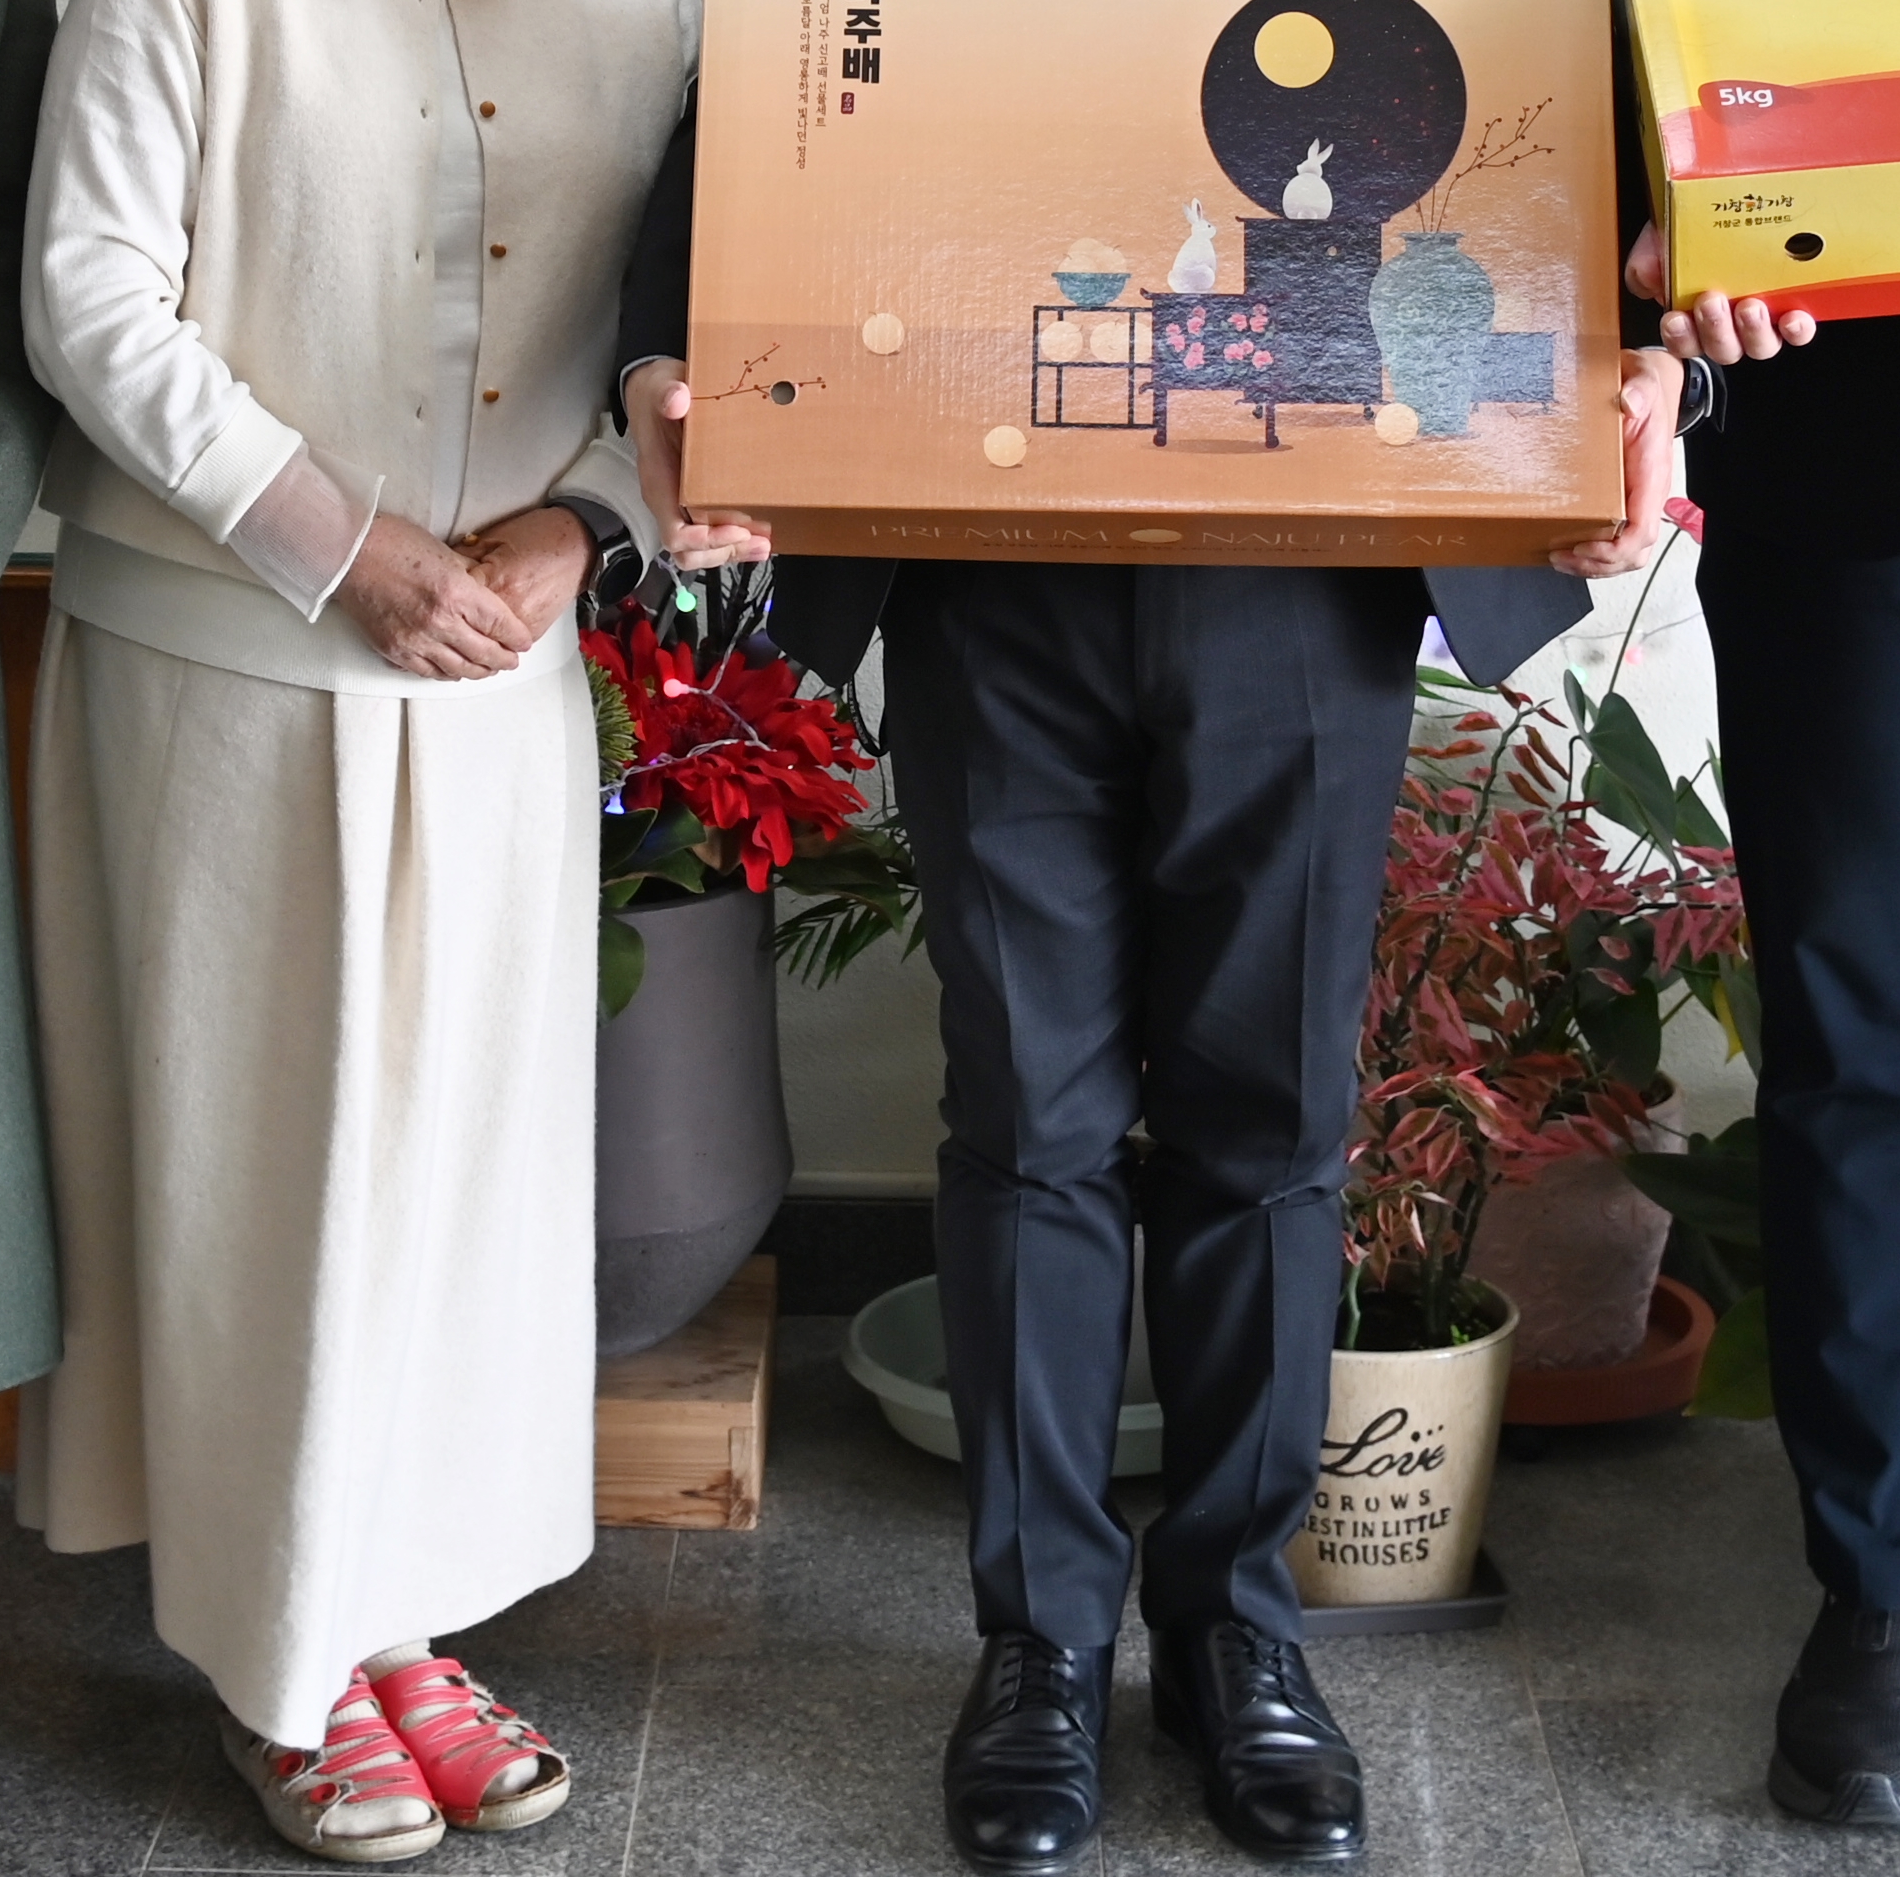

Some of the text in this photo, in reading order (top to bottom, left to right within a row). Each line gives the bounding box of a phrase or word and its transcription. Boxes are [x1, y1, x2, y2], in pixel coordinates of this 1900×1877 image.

[818, 17, 830, 40] 나주
[799, 31, 811, 55] 아래
[814, 81, 827, 127] 선물세트
[1718, 86, 1774, 108] 5kg
[870, 525, 1467, 547] PREMIUM NAJU PEAR
[1314, 1489, 1431, 1512] GROWS
[1352, 1519, 1376, 1538] IN
[1382, 1507, 1451, 1538] LITTLE
[1318, 1538, 1429, 1566] HOUSES
